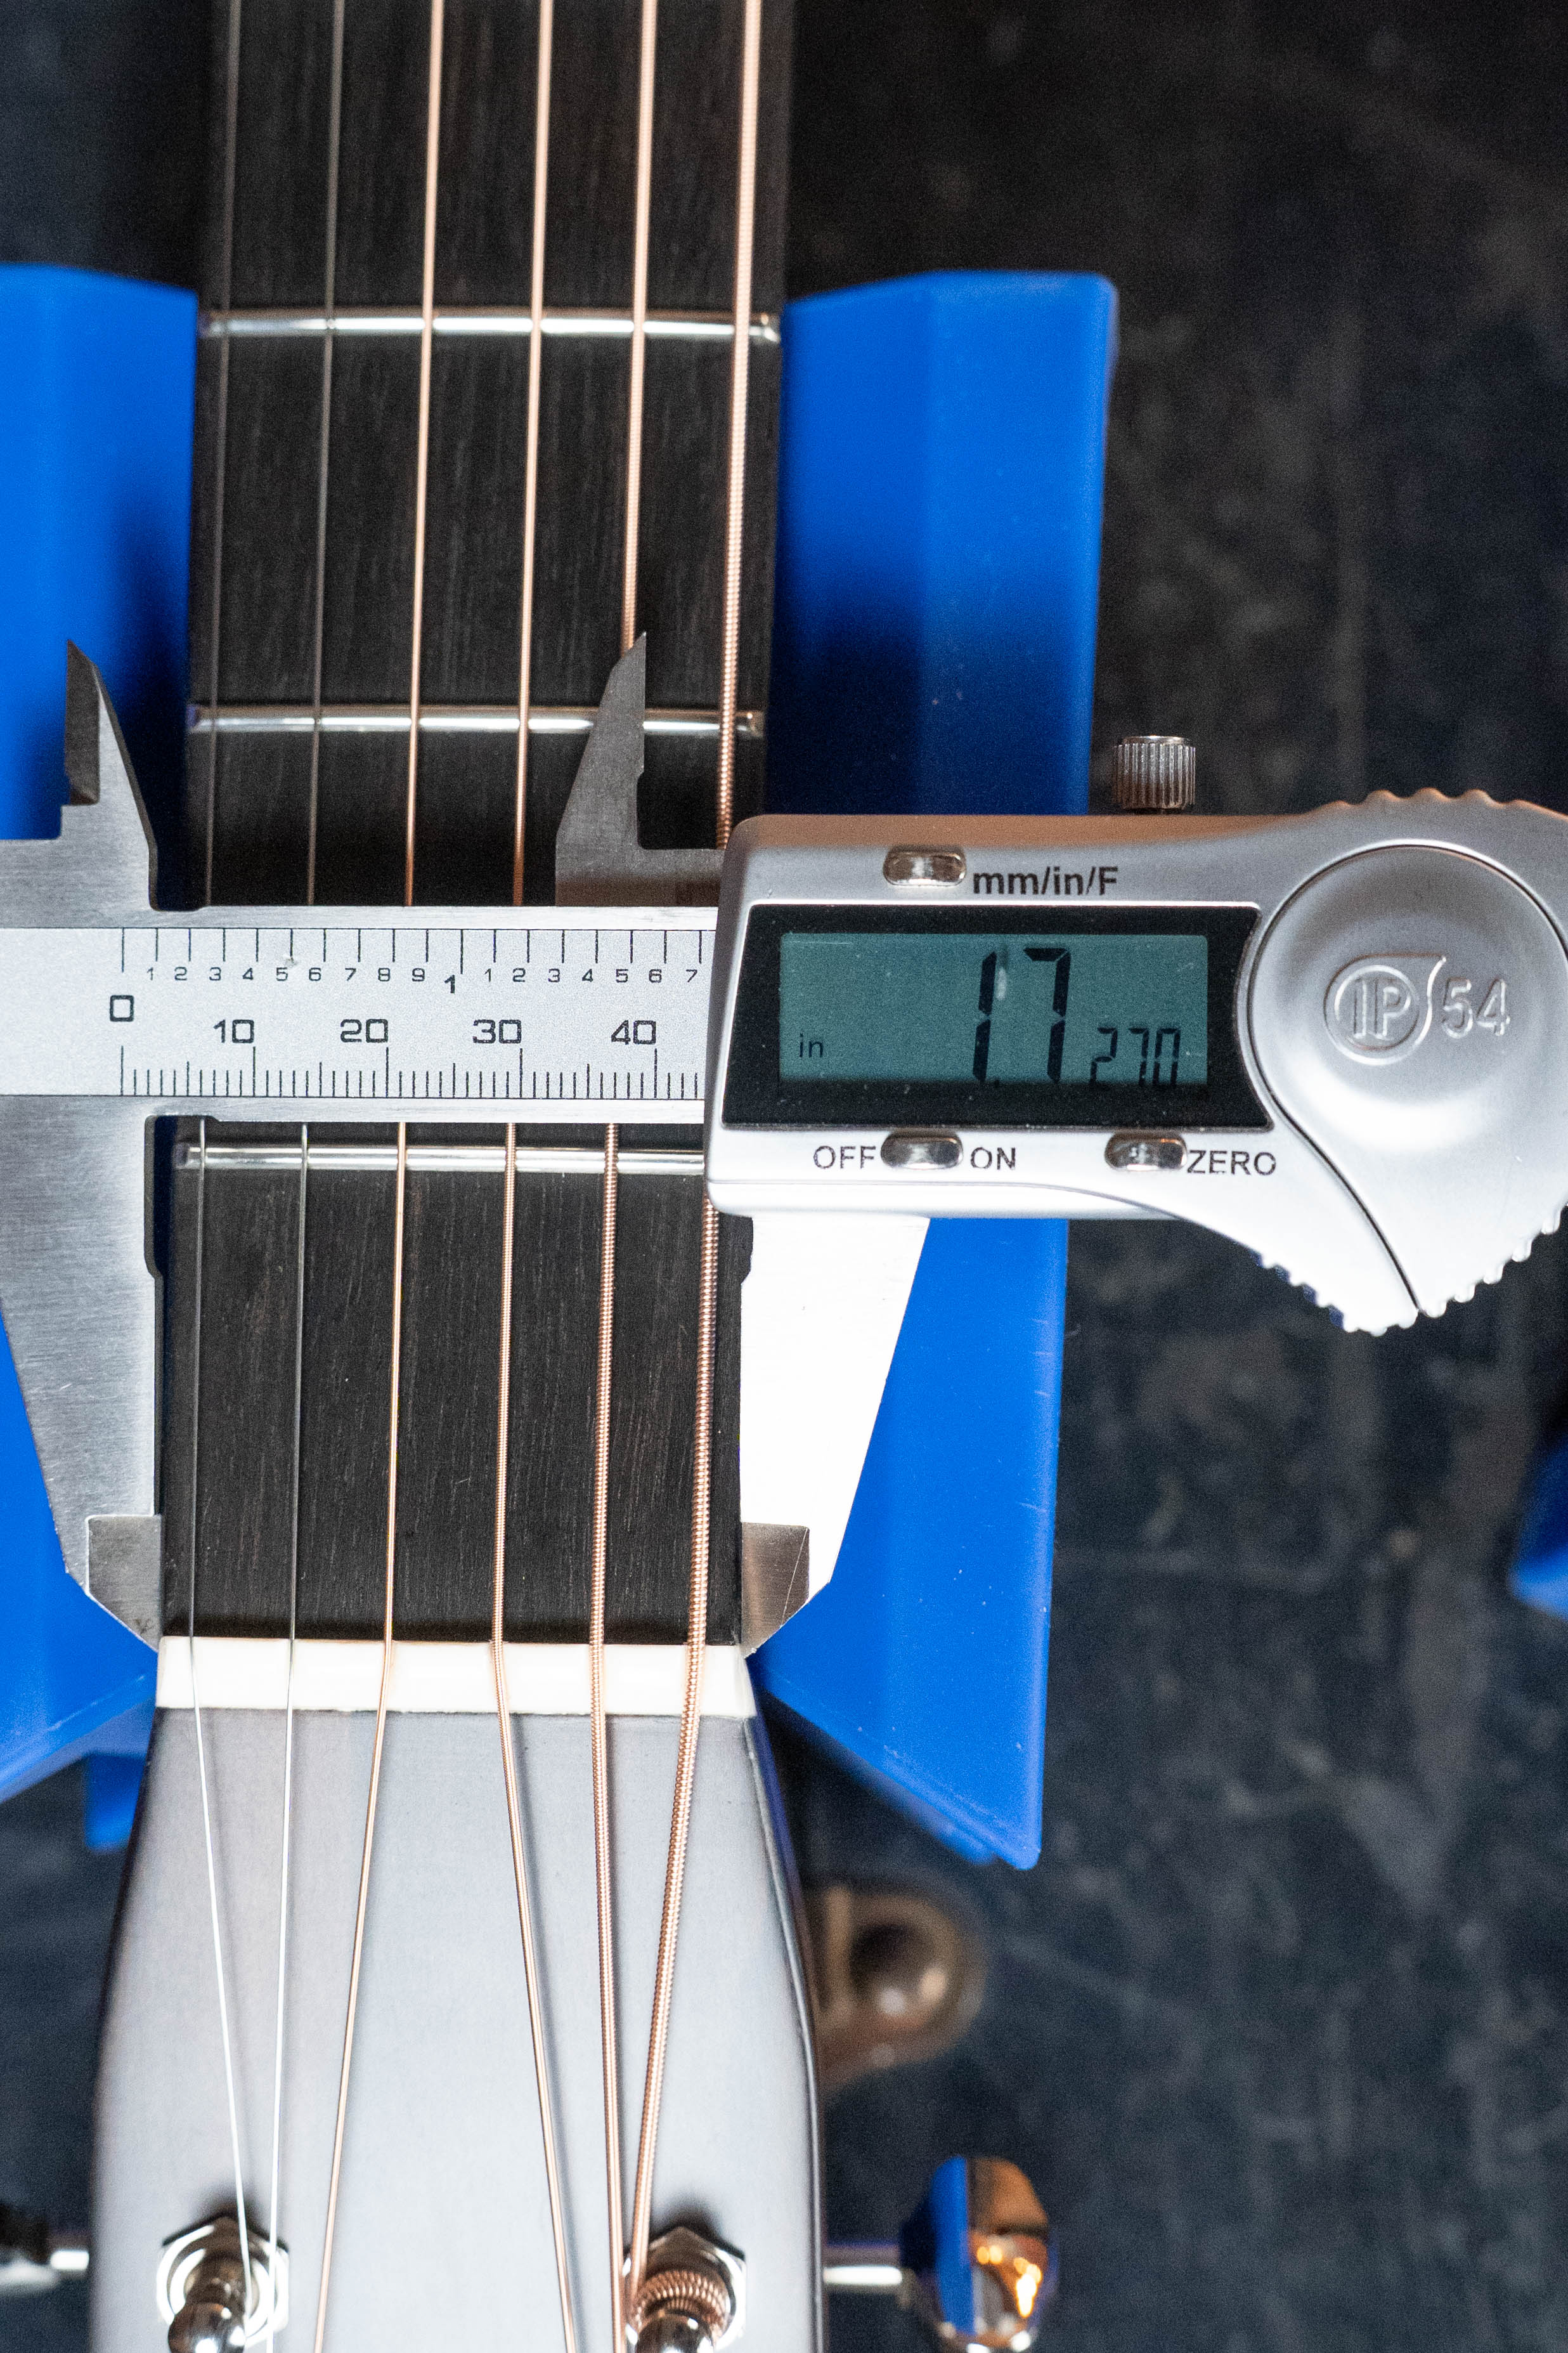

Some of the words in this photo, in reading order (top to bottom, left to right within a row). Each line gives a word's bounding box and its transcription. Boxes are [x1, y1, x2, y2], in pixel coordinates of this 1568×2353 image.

[973, 866, 1118, 896] mm/in/F
[146, 967, 154, 981] 1
[174, 967, 188, 981] 2
[209, 967, 222, 981] 3
[242, 967, 254, 981] 4
[276, 967, 288, 981] 5
[308, 967, 321, 981] 6
[344, 967, 357, 981] 7
[377, 967, 391, 982] 8
[411, 967, 425, 982] 9
[444, 974, 456, 994] 1
[484, 968, 492, 982] 1
[512, 968, 526, 982] 2
[548, 968, 561, 983] 3
[581, 968, 594, 982] 4
[616, 968, 629, 983] 5
[648, 968, 663, 983] 6
[685, 968, 699, 983] 7
[109, 994, 134, 1022] 0
[214, 1019, 254, 1044] 10
[340, 1019, 389, 1043] 20
[472, 1019, 522, 1044] 30
[611, 1020, 657, 1045] 40
[1352, 977, 1413, 1040] IP
[1441, 977, 1511, 1040] 54
[799, 1033, 824, 1058] in
[813, 1145, 876, 1169] OFF
[970, 1147, 1016, 1170] ON
[1187, 1149, 1276, 1176] ZERO
